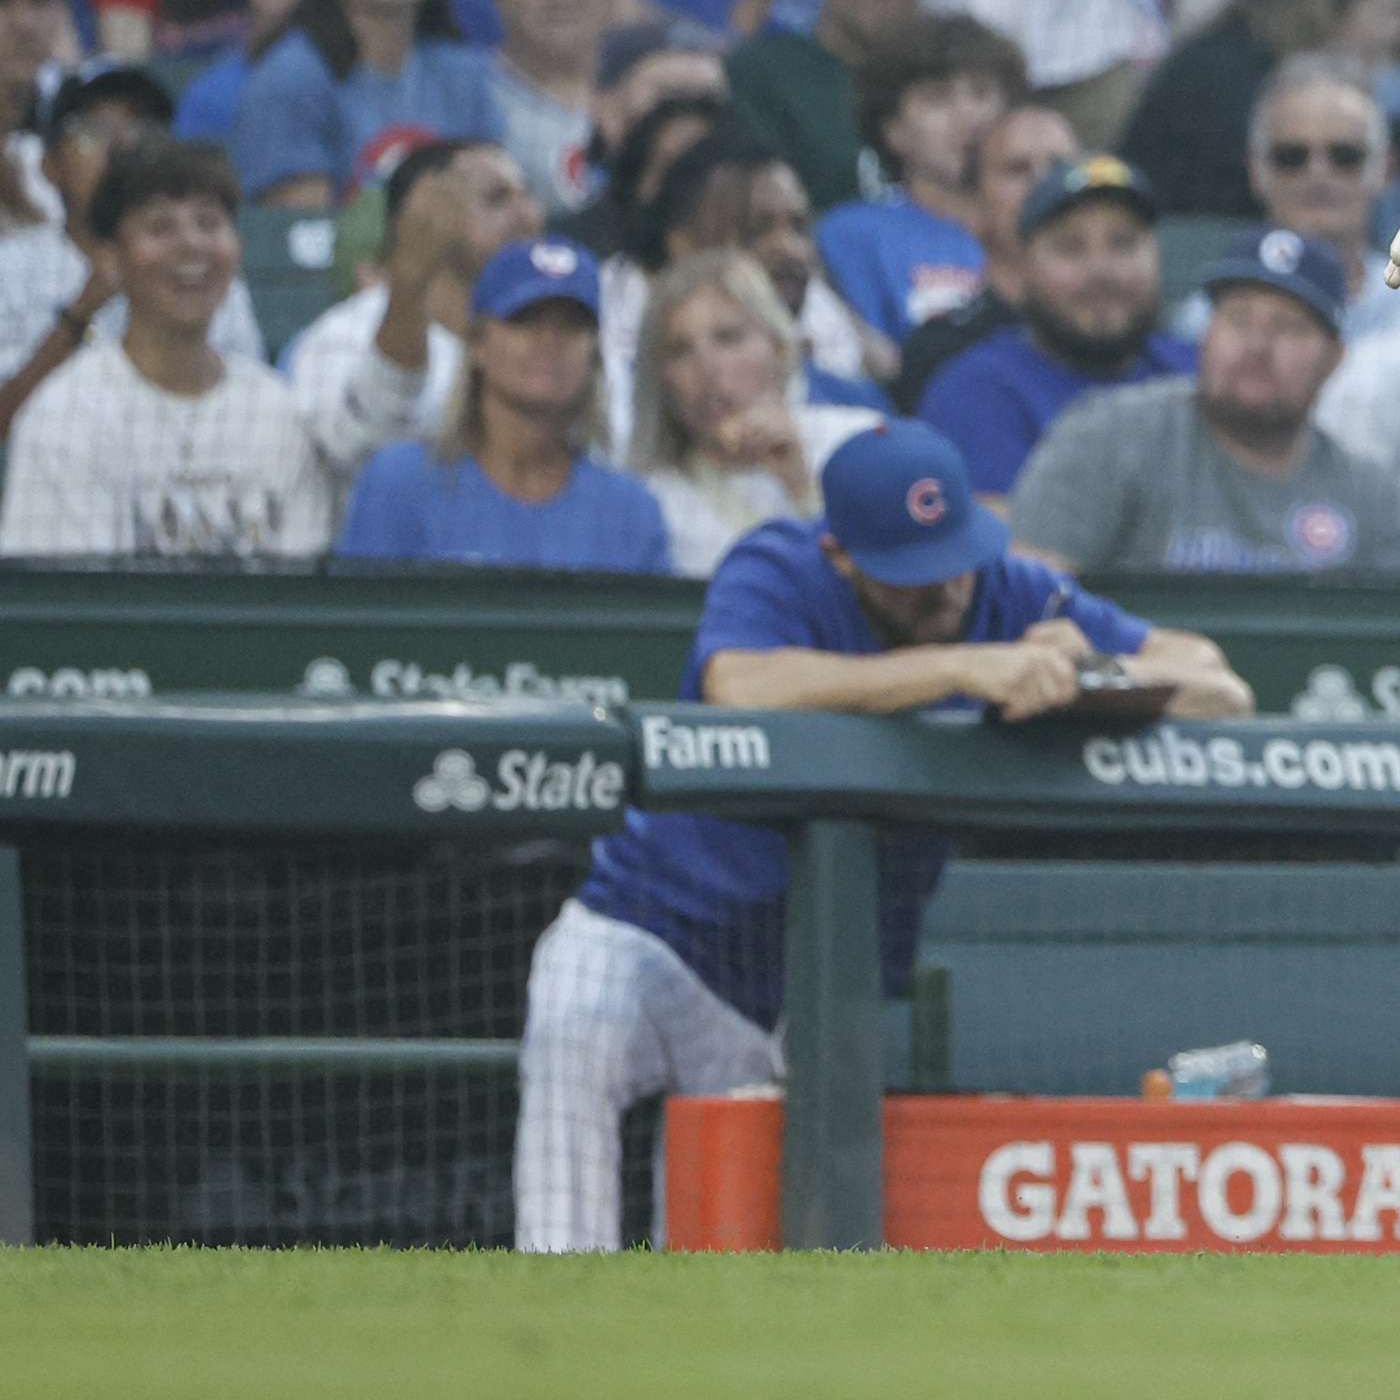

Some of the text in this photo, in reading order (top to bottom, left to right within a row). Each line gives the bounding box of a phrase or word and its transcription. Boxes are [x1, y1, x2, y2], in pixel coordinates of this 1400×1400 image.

[0, 750, 75, 798] rm
[493, 715, 771, 811] State Farm
